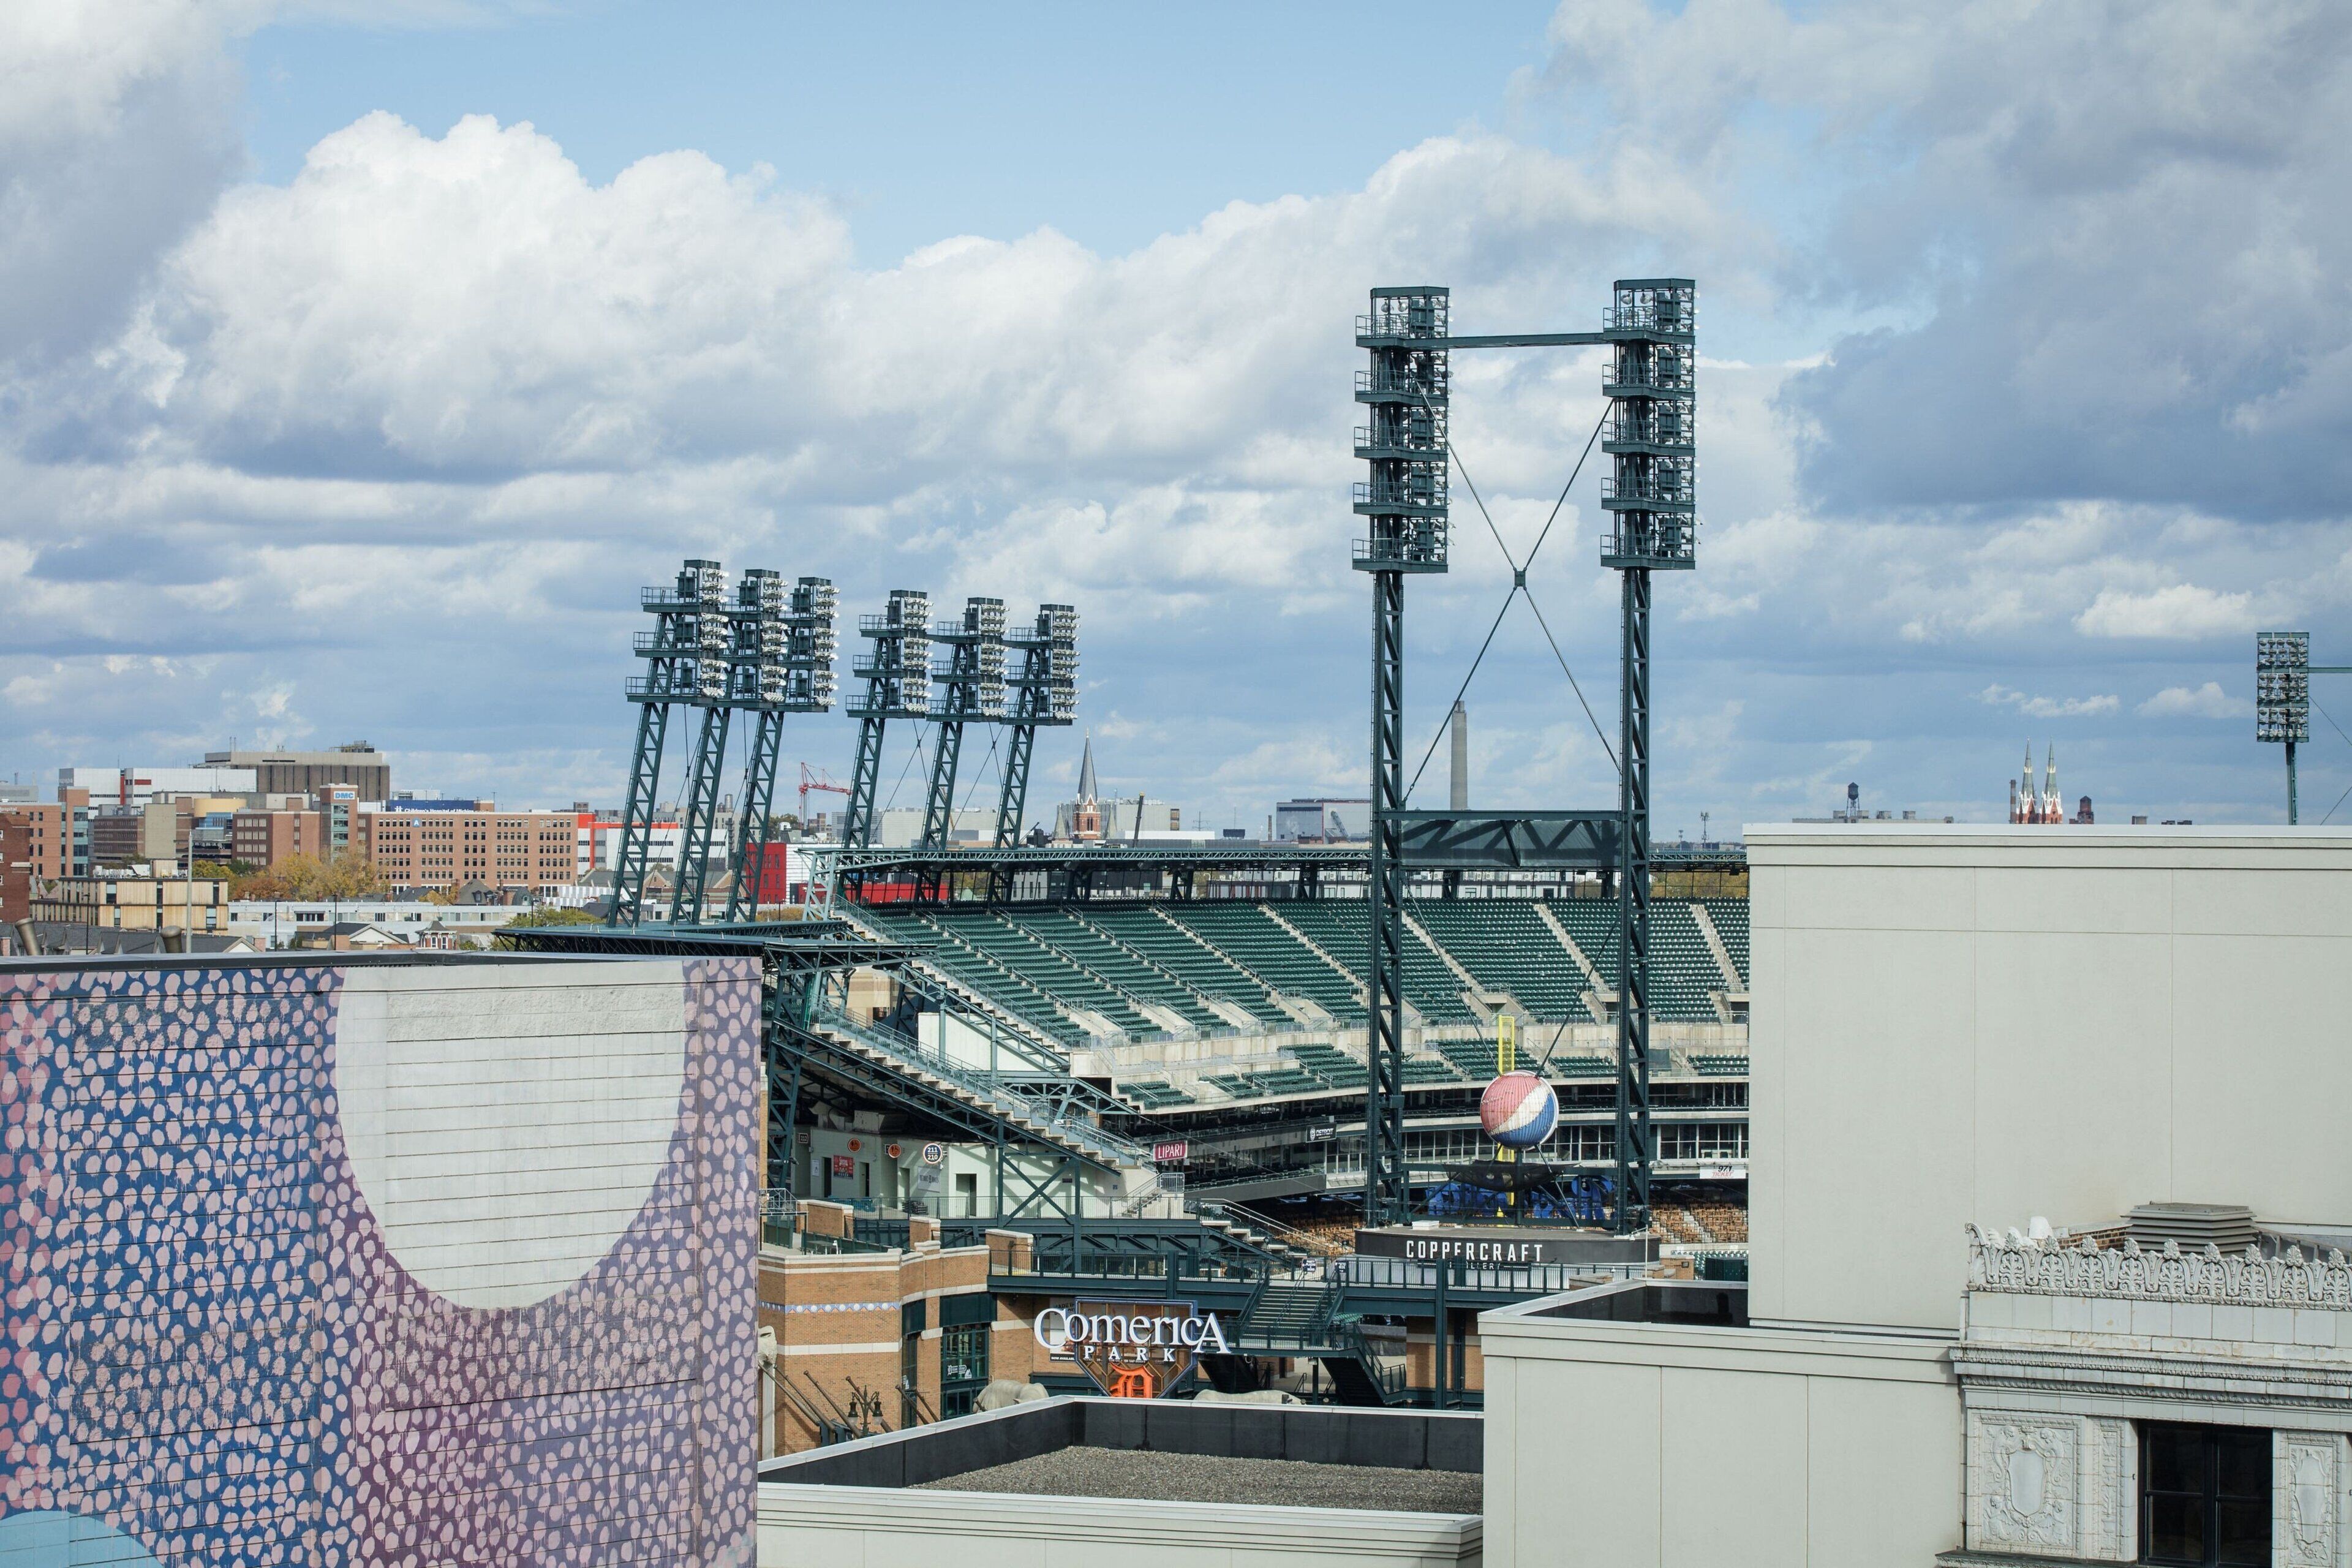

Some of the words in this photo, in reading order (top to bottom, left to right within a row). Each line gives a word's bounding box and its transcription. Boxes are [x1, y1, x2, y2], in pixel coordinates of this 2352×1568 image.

[1158, 1144, 1182, 1159] LIPARI
[1406, 1240, 1542, 1262] COPPERCRAFT
[1084, 1345, 1176, 1362] PARK
